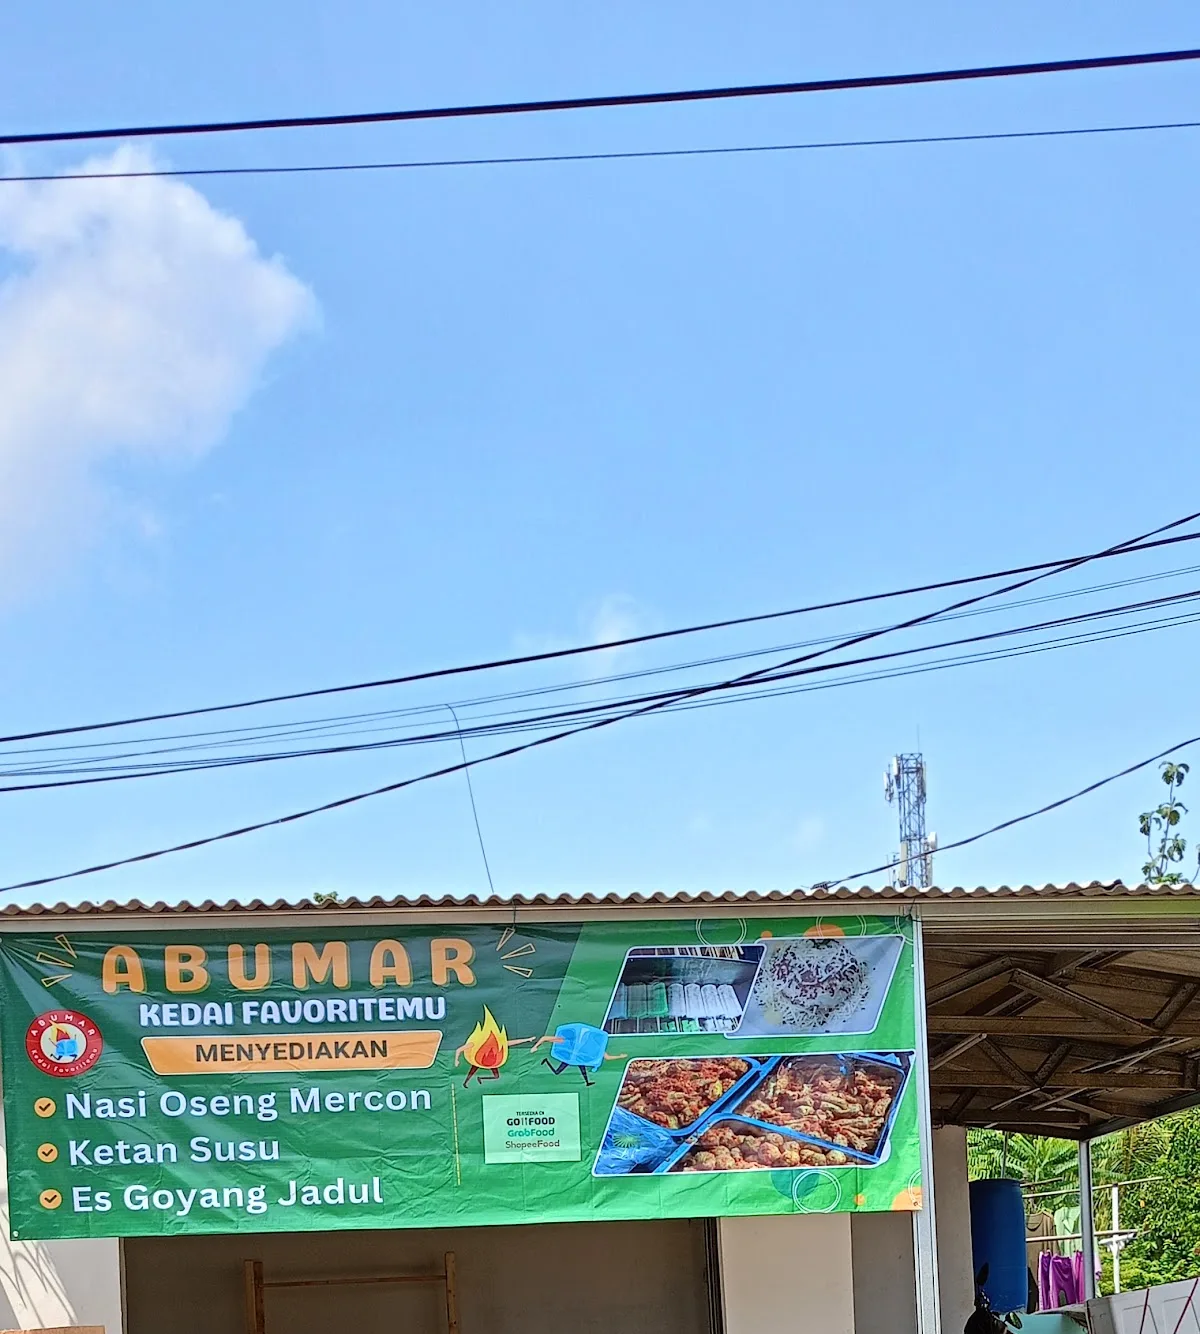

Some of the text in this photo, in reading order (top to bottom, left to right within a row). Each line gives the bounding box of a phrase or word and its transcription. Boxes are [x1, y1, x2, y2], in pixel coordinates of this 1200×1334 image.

[102, 938, 477, 993] ABUMAR
[31, 1014, 96, 1036] ABUMAR
[139, 997, 446, 1027] KEDAI FAVORITEMU
[195, 1040, 388, 1062] MENYEDIAKAN
[66, 1087, 431, 1121] Nasi Oseng Mercon
[505, 1140, 560, 1150] ShopeeFood
[507, 1128, 555, 1137] GrabFood
[69, 1137, 280, 1165] Ketan Susu
[72, 1177, 383, 1216] Es Goyang Jadul
